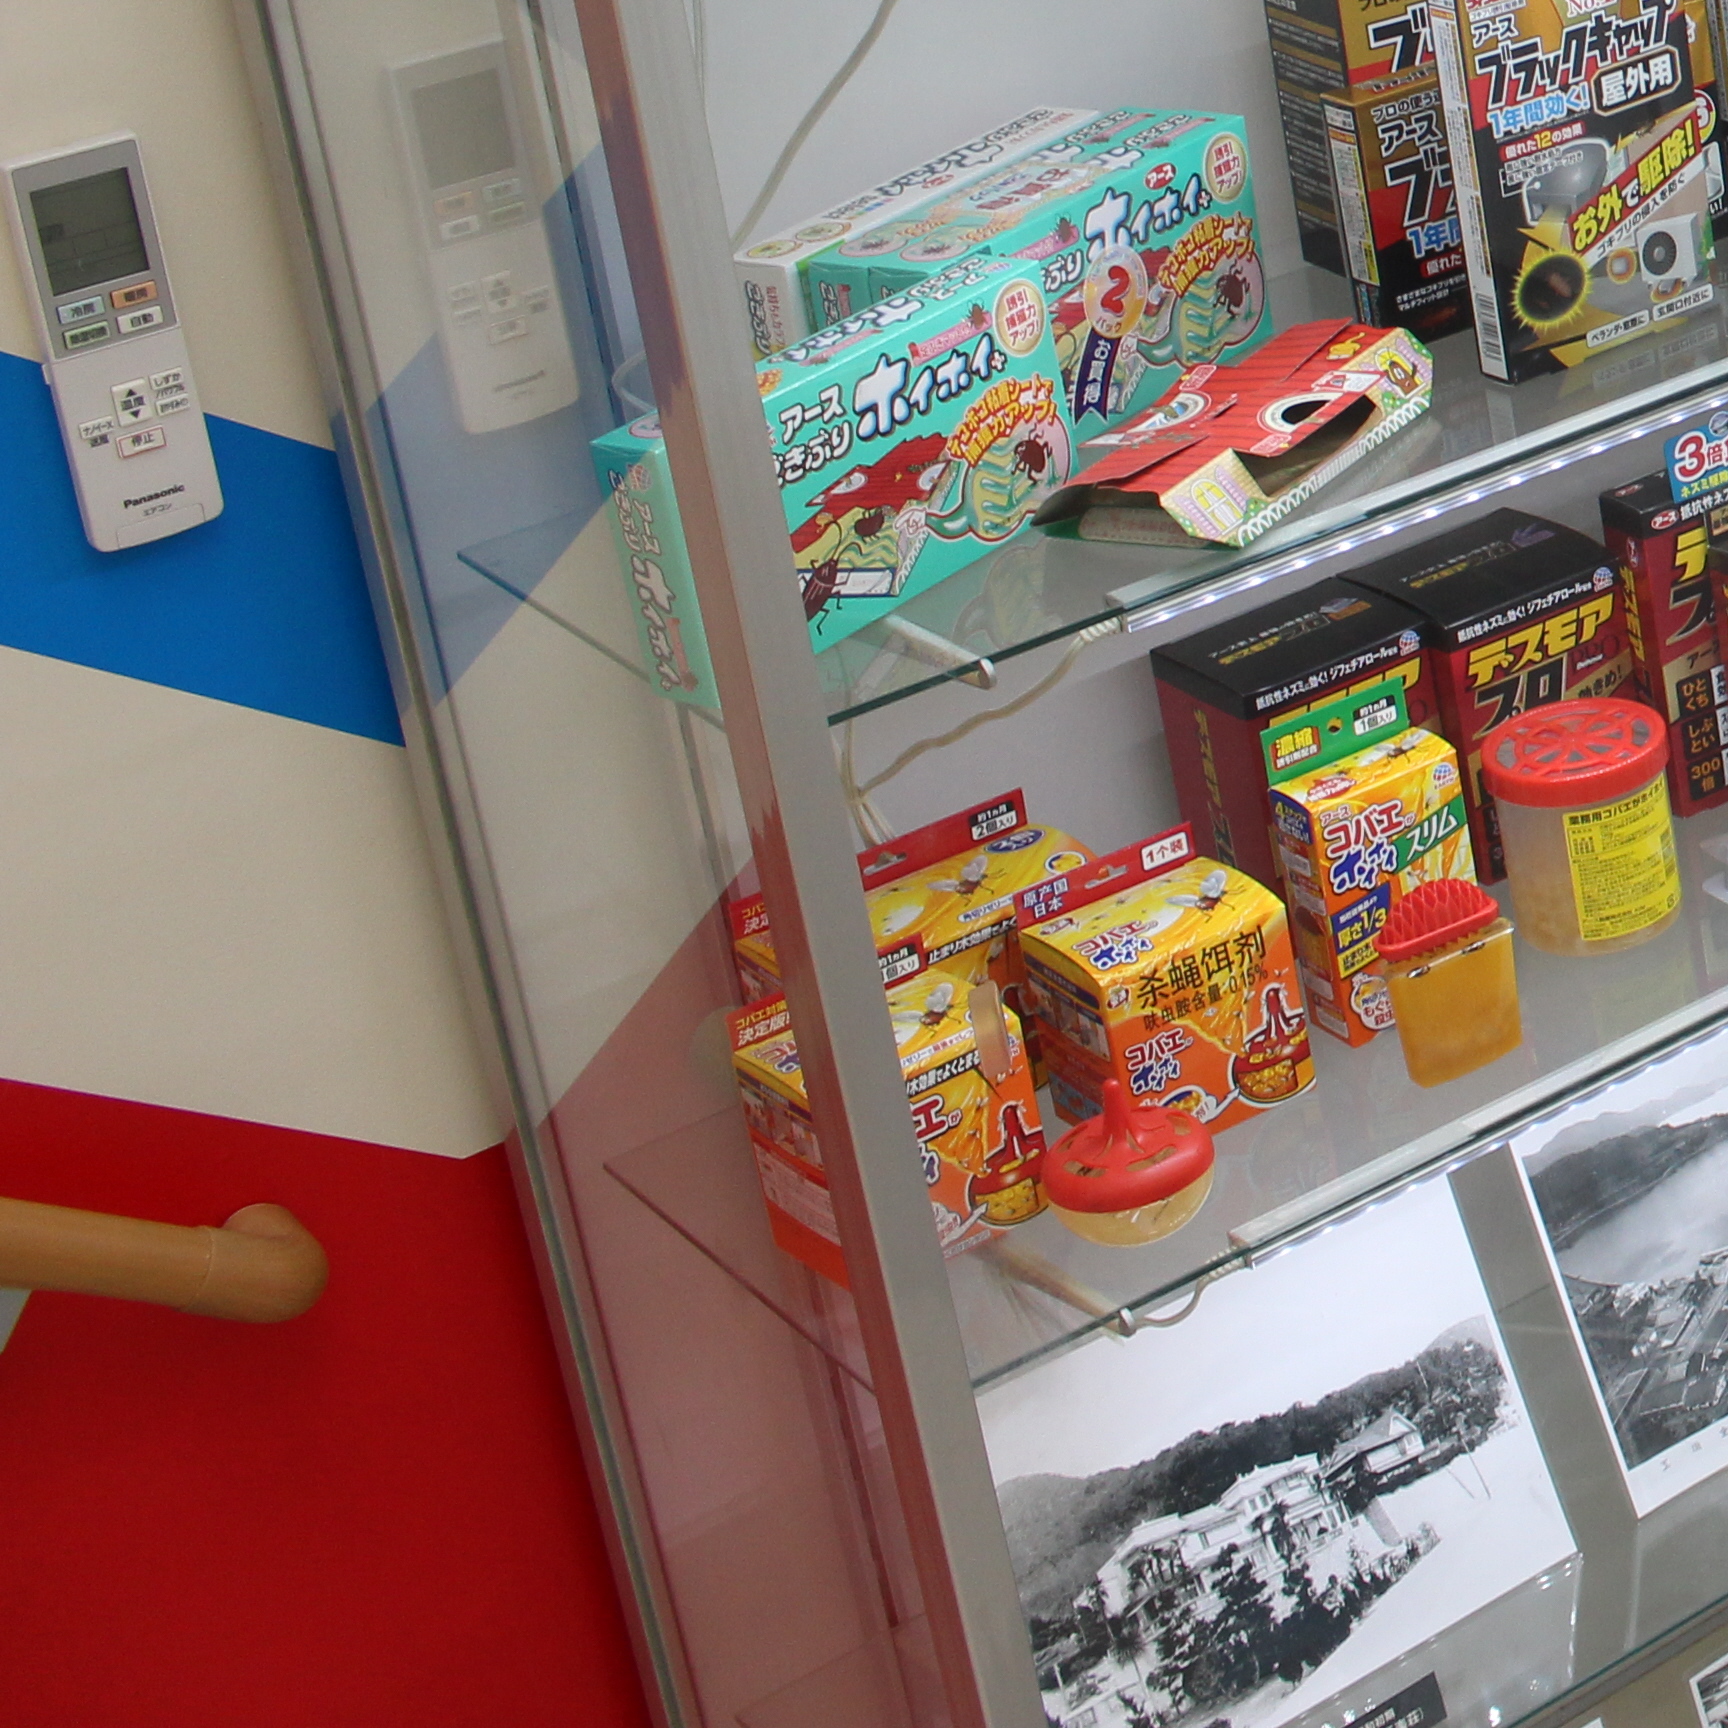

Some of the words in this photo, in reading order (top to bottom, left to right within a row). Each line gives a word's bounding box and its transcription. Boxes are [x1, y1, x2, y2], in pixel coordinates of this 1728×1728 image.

[1471, 15, 1518, 47] アース
[1600, 56, 1674, 107] 屋外用
[1377, 108, 1440, 156] アース
[1485, 82, 1591, 140] 1年間効く!
[1503, 123, 1586, 160] 優れた12の効果
[1146, 165, 1175, 189] アース
[1572, 131, 1698, 251] お外で駆除!
[1101, 264, 1131, 315] 2
[779, 383, 848, 445] アース
[123, 483, 186, 510] Panasonic
[1468, 592, 1614, 690] デスモア
[1406, 810, 1459, 856] スリム
[1023, 879, 1068, 907] 原产国
[1033, 894, 1063, 917] 日本
[1136, 923, 1268, 1012] 杀蝇饵剂
